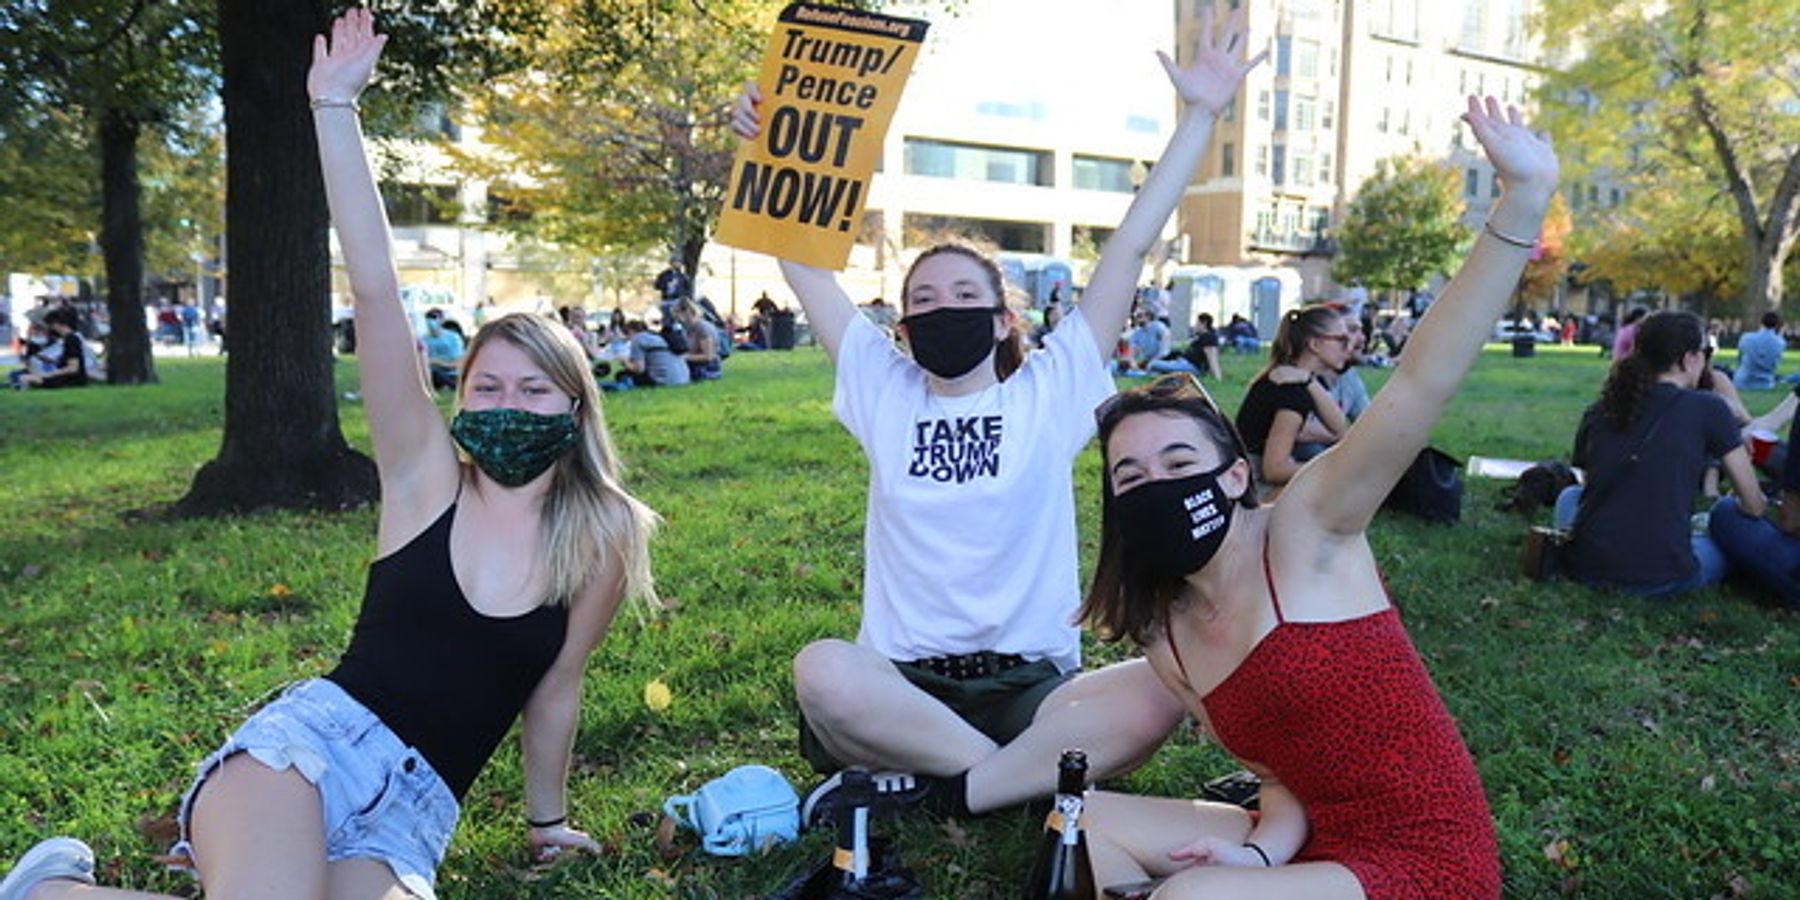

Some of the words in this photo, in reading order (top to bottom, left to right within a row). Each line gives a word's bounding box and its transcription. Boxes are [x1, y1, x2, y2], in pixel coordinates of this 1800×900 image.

[782, 28, 905, 77] Trump/
[775, 64, 877, 109] Pence
[767, 105, 864, 167] OUT
[732, 160, 862, 232] NOW!
[913, 439, 1000, 466] TRUMP
[916, 415, 1003, 445] TAKE
[908, 453, 1000, 484] DOWN
